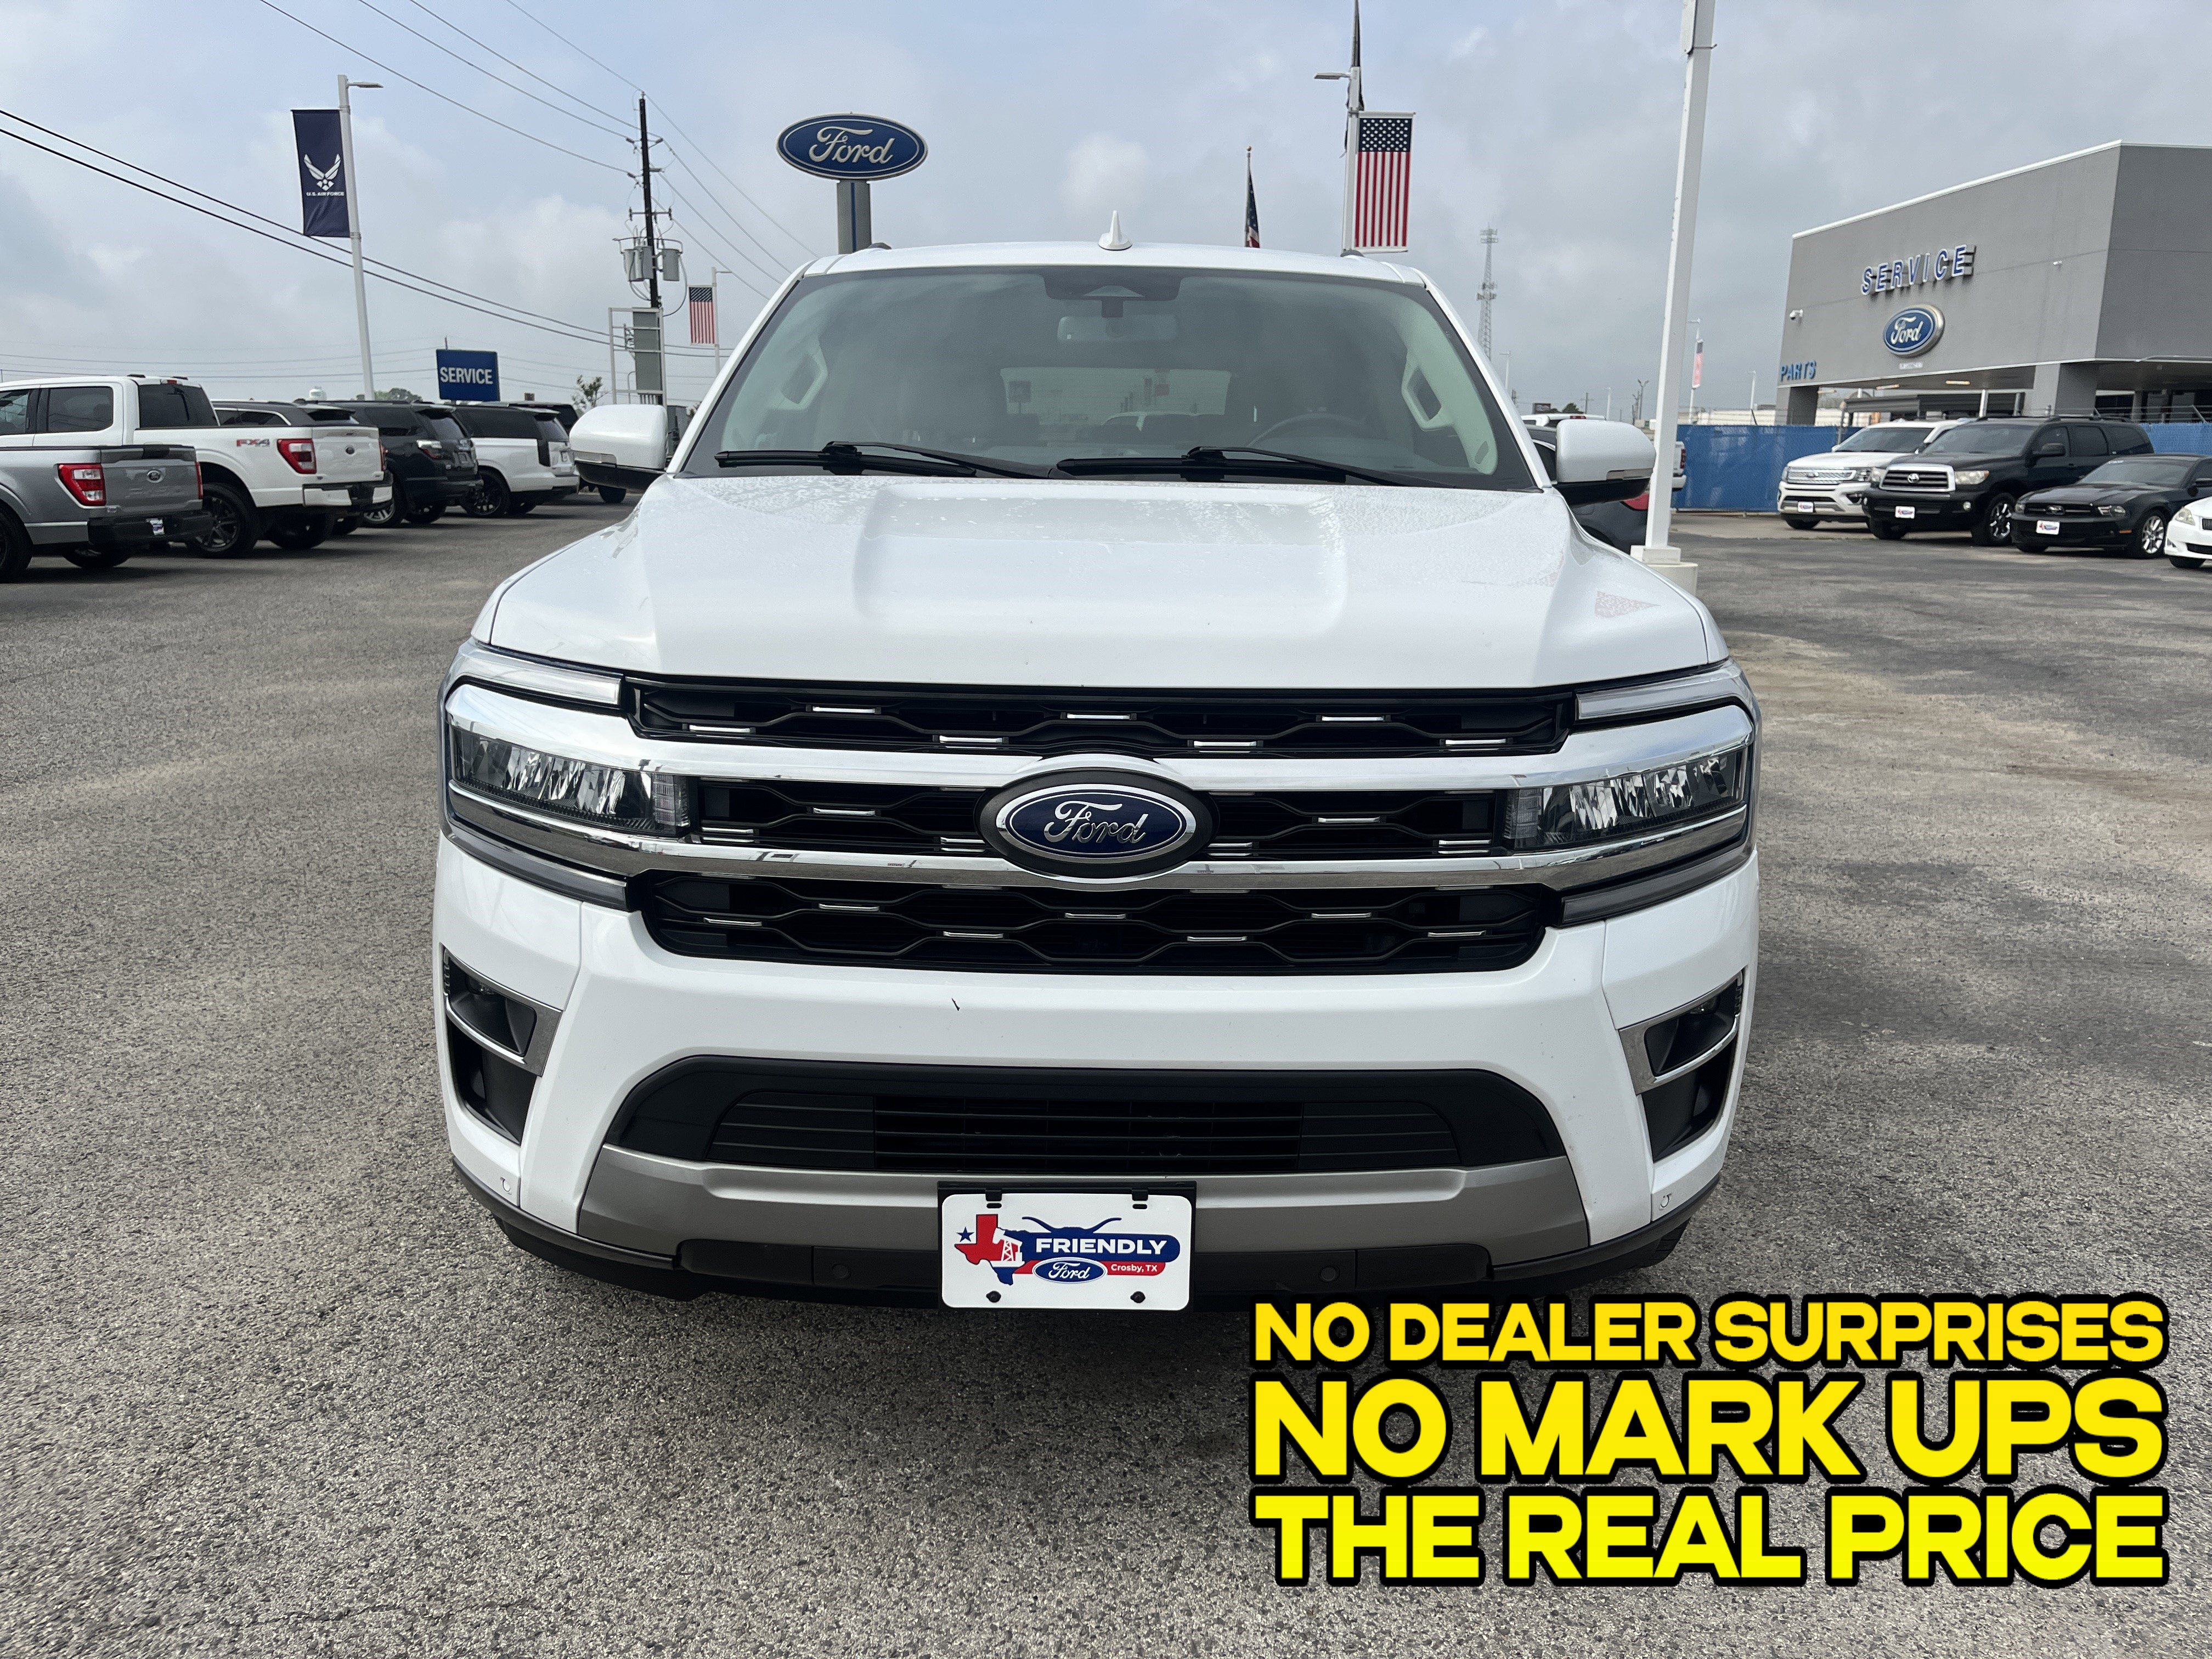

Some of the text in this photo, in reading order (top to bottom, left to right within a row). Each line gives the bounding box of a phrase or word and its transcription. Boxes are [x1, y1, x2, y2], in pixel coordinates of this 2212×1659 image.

[809, 126, 895, 163] Ford
[1860, 244, 1968, 296] SERVICE
[1890, 315, 1924, 345] Ford
[439, 366, 494, 385] SERVICE
[1780, 359, 1817, 382] PARTS
[1043, 800, 1149, 844] Ford
[1035, 1238, 1167, 1255] FRIENDLY
[1048, 1261, 1090, 1280] Ford
[1110, 1263, 1158, 1274] Crosby, TX
